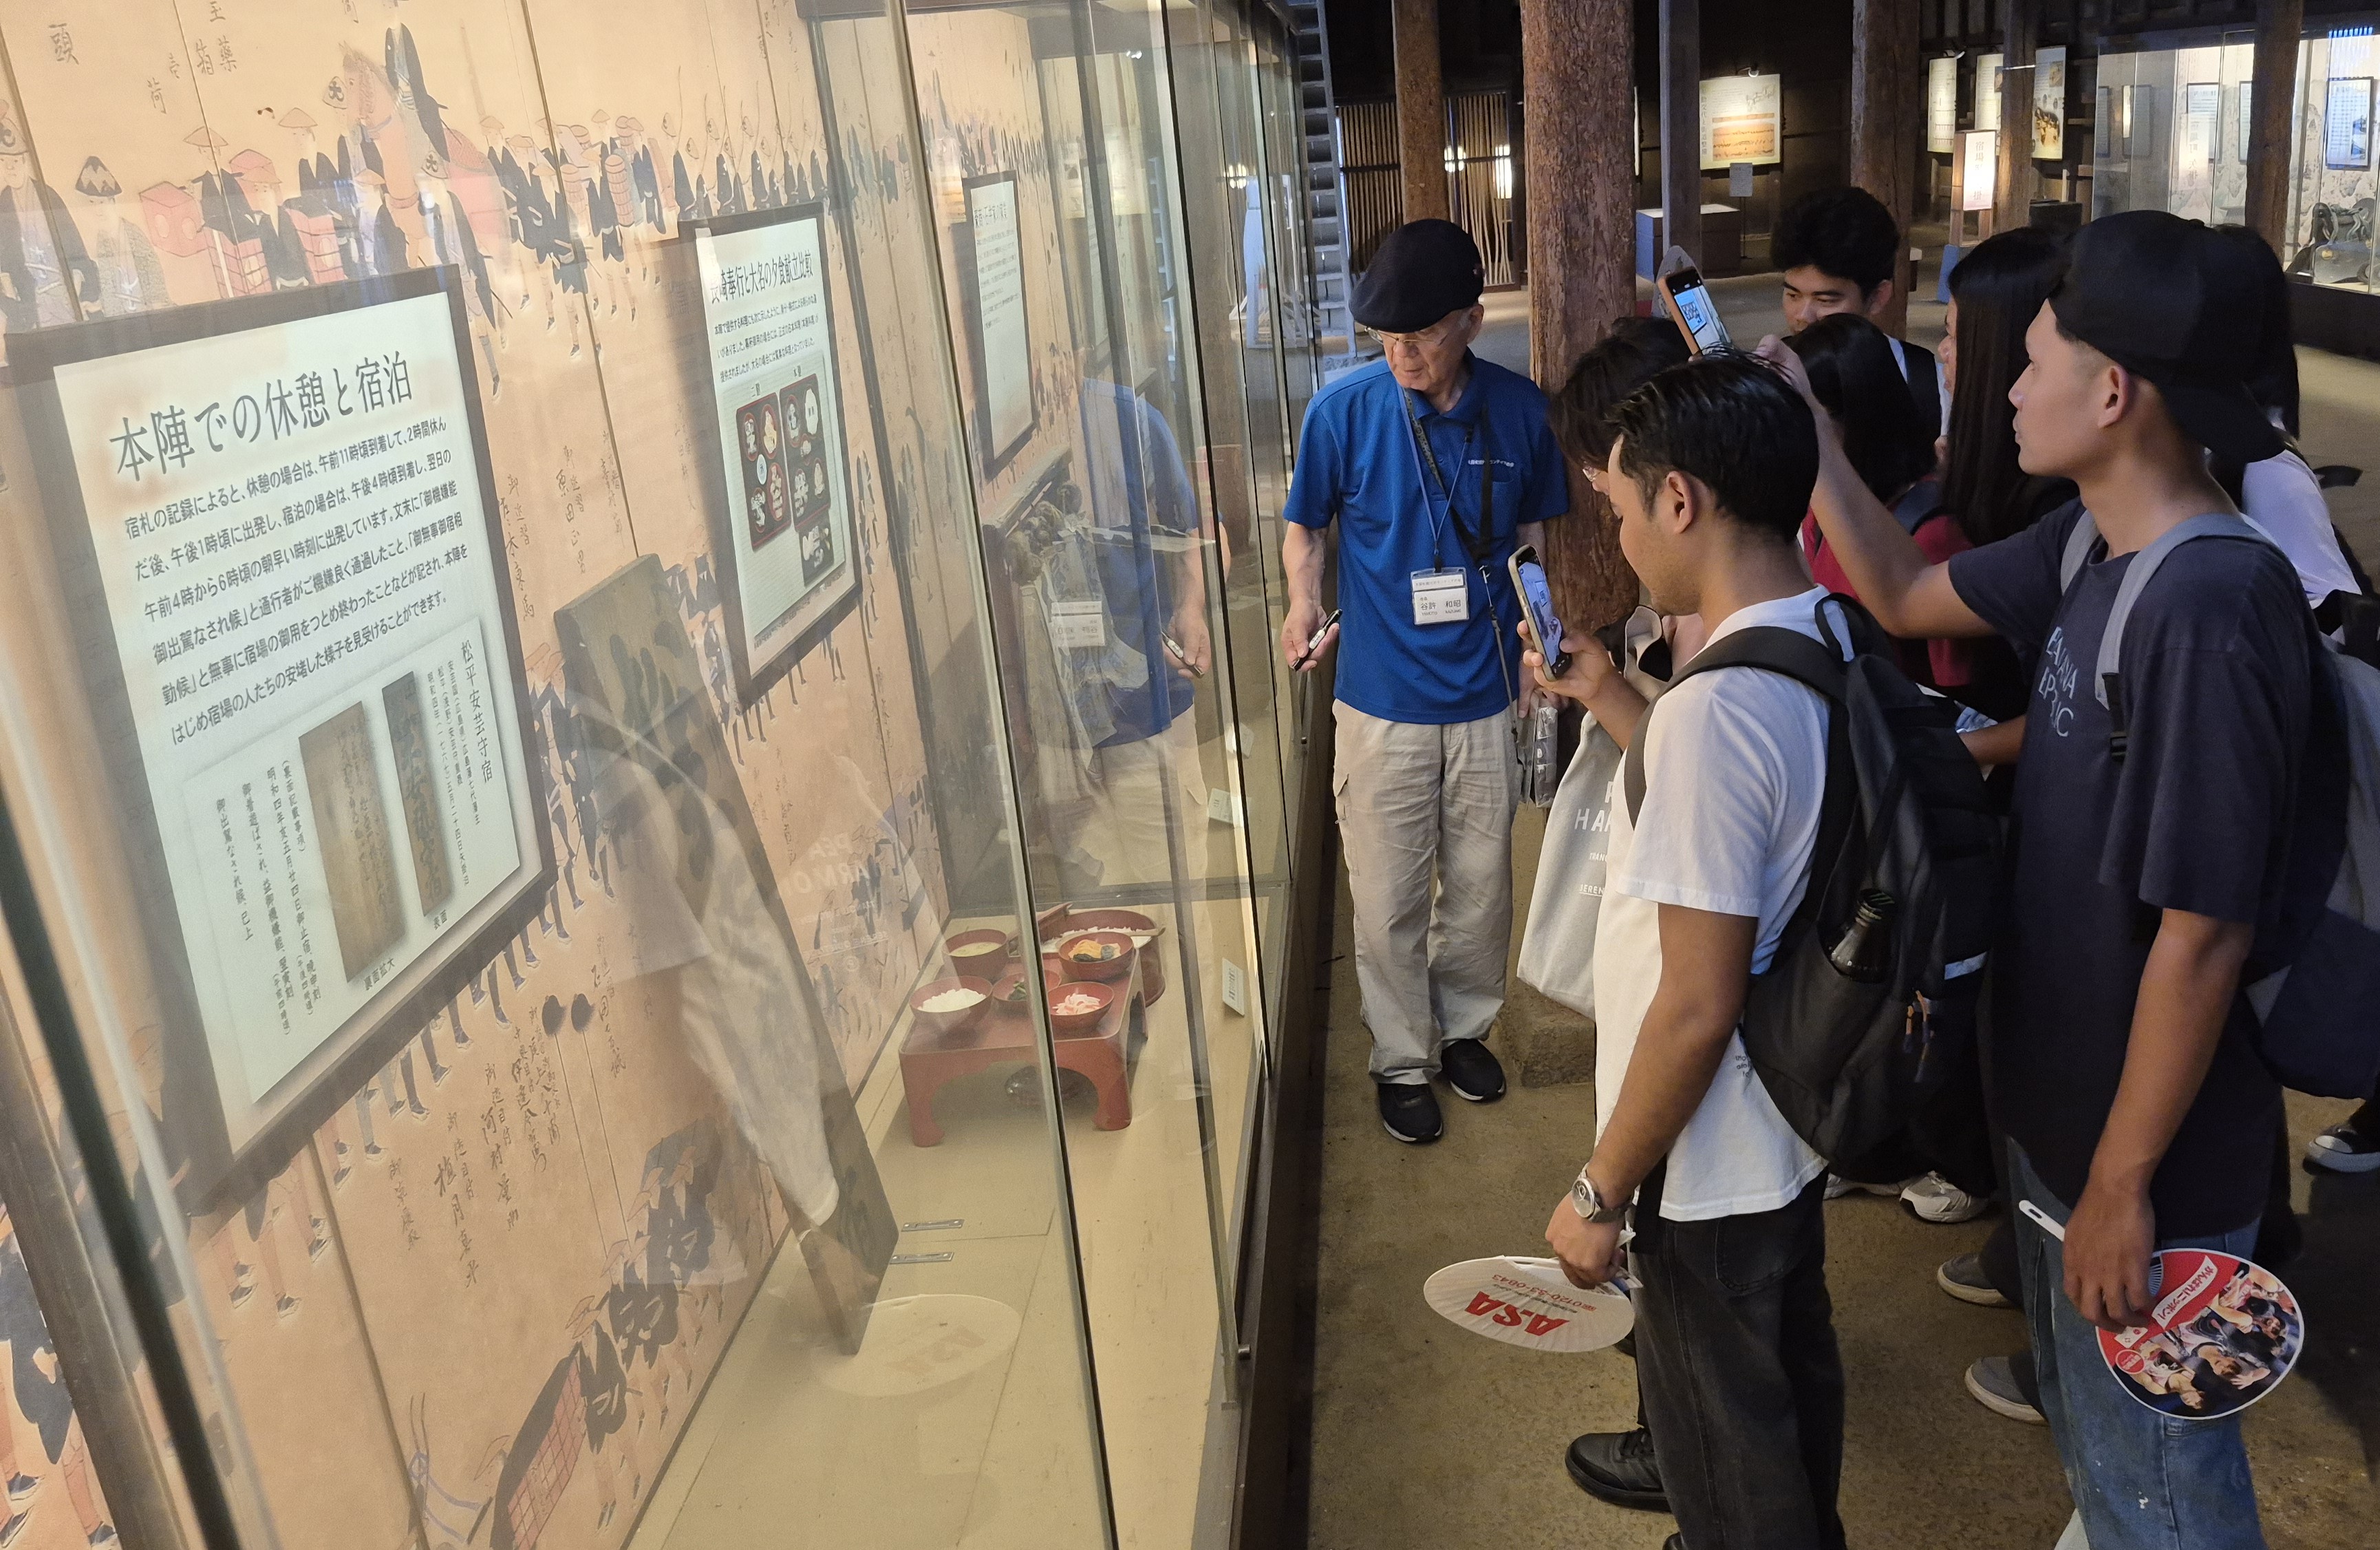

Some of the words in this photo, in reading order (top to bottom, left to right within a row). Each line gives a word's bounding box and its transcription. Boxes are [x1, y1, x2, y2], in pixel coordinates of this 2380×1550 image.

[109, 350, 411, 481] 本陣での休憩と宿泊
[1446, 599, 1461, 608] 和昭
[461, 639, 492, 783] 松平安芸守宿
